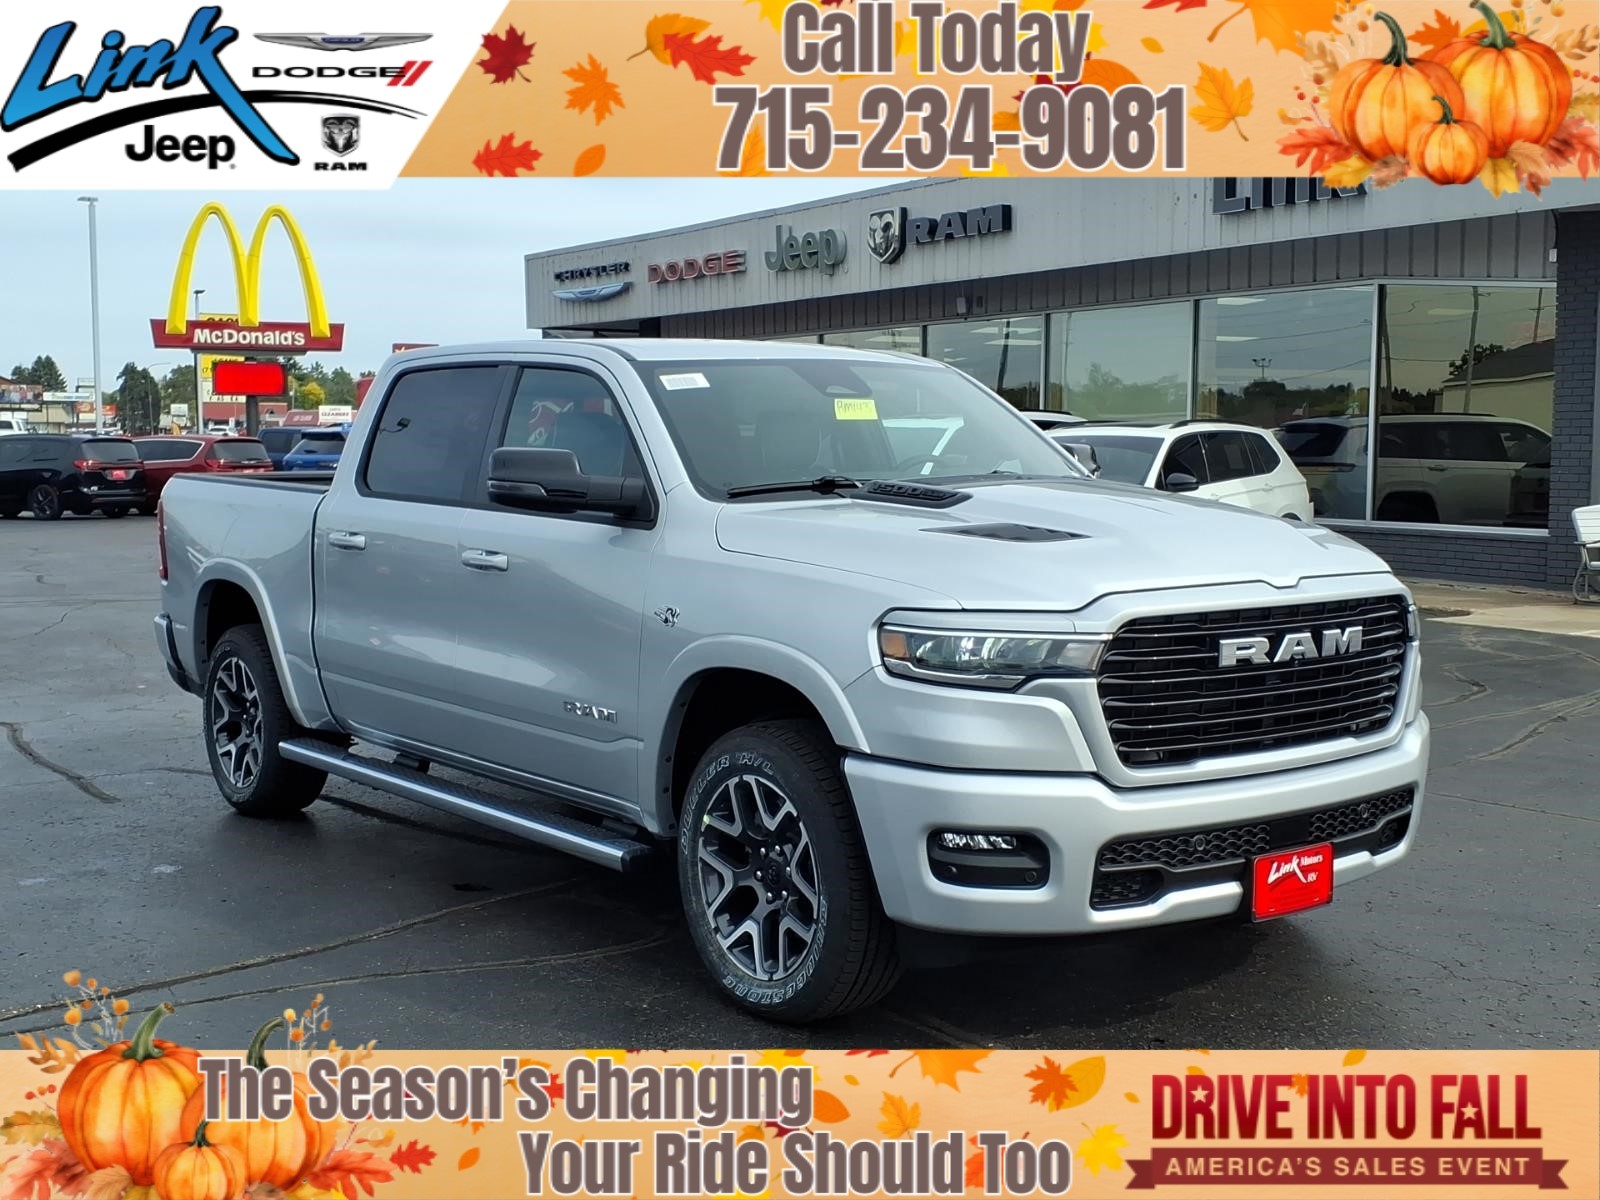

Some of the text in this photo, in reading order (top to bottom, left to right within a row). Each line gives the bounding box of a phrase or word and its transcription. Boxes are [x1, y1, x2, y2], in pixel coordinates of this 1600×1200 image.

[906, 204, 1012, 245] RAM
[764, 224, 847, 275] Jeep
[554, 261, 631, 282] CHRYSLER
[648, 250, 746, 284] DODGE
[193, 328, 305, 346] McDonald's
[1219, 626, 1363, 667] RAM
[1267, 855, 1307, 884] Link
